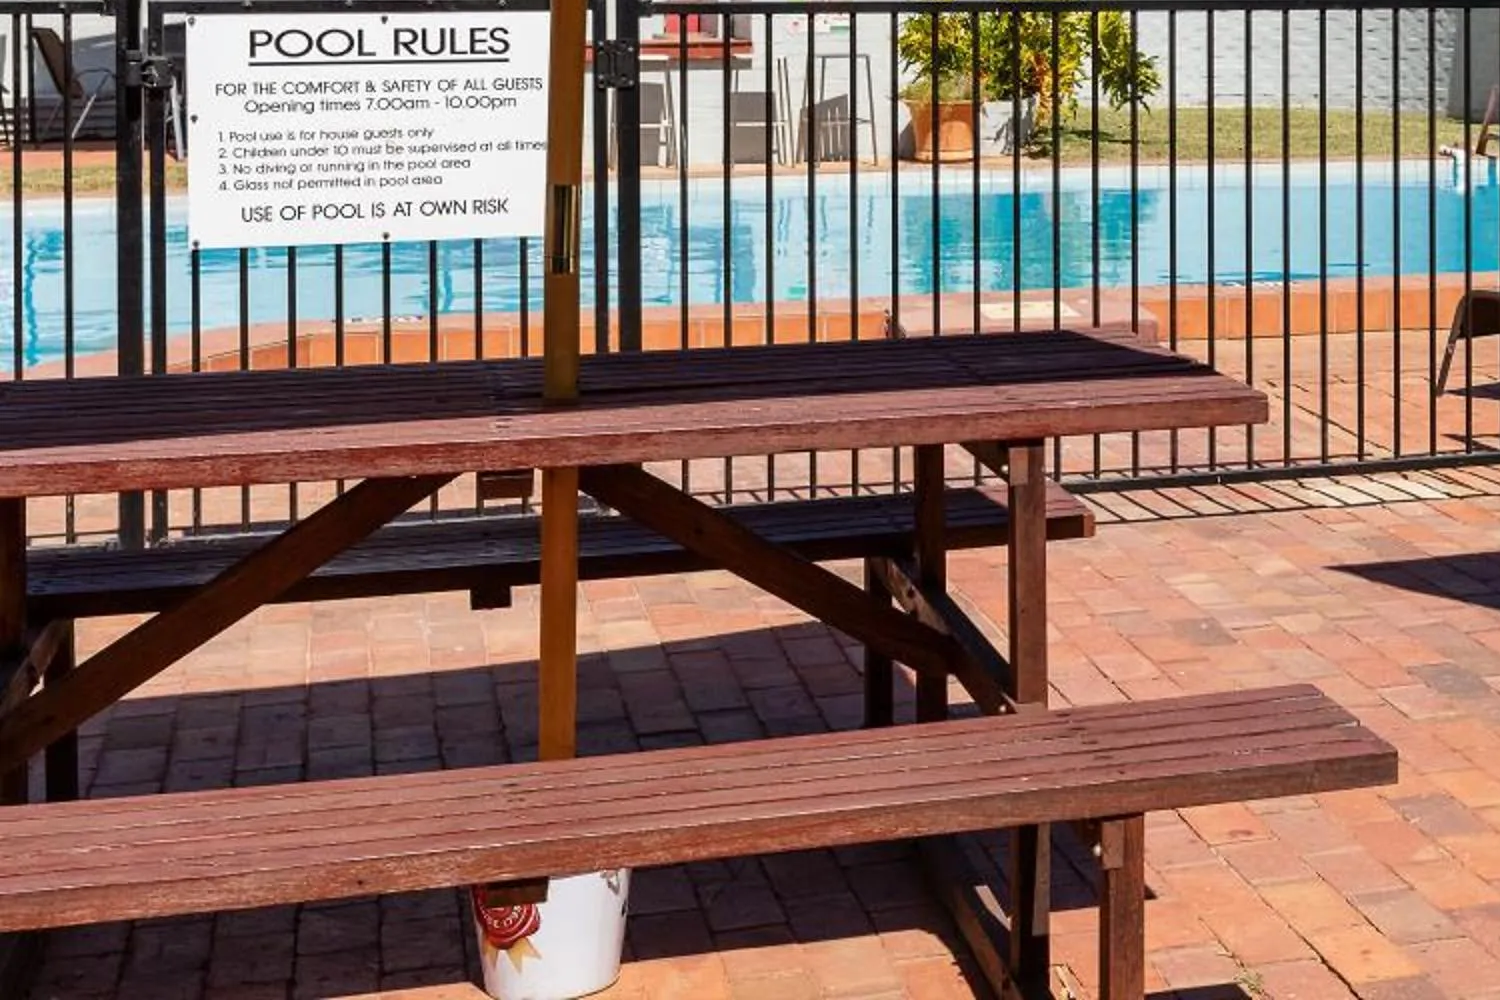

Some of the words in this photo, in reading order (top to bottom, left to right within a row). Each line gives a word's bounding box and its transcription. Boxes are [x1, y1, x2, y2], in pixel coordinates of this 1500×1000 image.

[249, 28, 377, 58] POOL
[393, 26, 511, 56] RULES
[215, 82, 247, 97] FOR
[252, 81, 277, 95] THE
[281, 80, 360, 95] COMFORT
[365, 79, 377, 93] &
[382, 79, 431, 93] SAFETY
[437, 78, 458, 93] OF
[463, 78, 487, 92] ALL
[491, 76, 543, 91] GUESTS
[244, 98, 315, 115] Opening
[319, 98, 361, 111] times
[365, 95, 430, 111] 7.00am
[445, 94, 517, 111] 10.00pm
[229, 130, 257, 143] Pool
[259, 131, 283, 142] use
[299, 129, 316, 141] for
[319, 128, 359, 140] house
[363, 127, 403, 141] guests
[407, 127, 434, 140] only
[232, 146, 287, 159] Children
[290, 145, 329, 158] under
[333, 144, 349, 157] 10
[351, 144, 383, 156] must
[385, 143, 405, 155] be
[407, 140, 477, 155] supervised
[479, 141, 493, 153] at
[496, 140, 511, 151] all
[515, 139, 547, 151] times
[232, 162, 252, 175] No
[255, 161, 296, 176] diving
[317, 160, 365, 173] running
[367, 159, 380, 171] in
[383, 158, 405, 171] the
[407, 157, 437, 171] pool
[440, 158, 471, 170] area
[233, 178, 269, 191] Glass
[273, 178, 293, 190] not
[297, 175, 361, 191] permitted
[363, 176, 376, 187] in
[379, 174, 409, 188] pool
[411, 175, 443, 186] area
[240, 205, 273, 223] USE
[279, 205, 306, 221] OF
[311, 202, 365, 220] POOL
[371, 201, 386, 219] IS
[393, 200, 413, 217] AT
[419, 199, 467, 217] OWN
[472, 197, 509, 215] RISK
